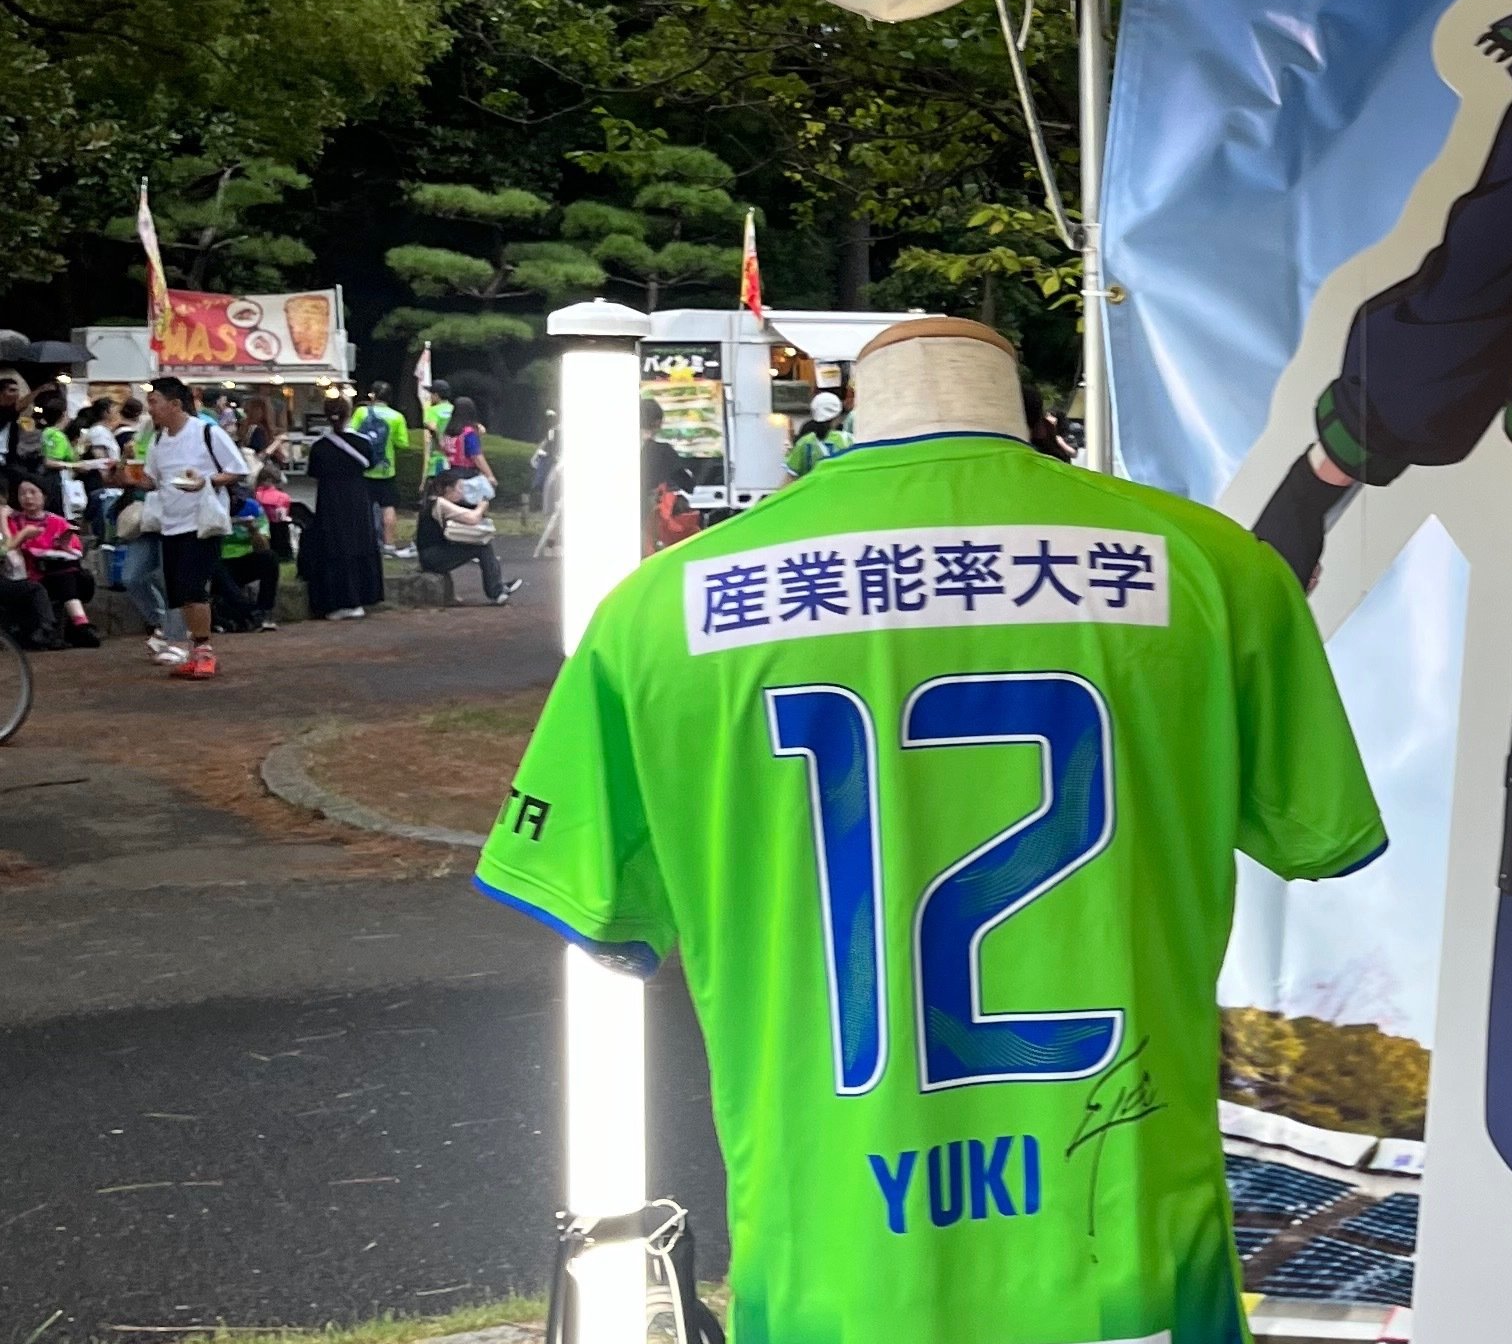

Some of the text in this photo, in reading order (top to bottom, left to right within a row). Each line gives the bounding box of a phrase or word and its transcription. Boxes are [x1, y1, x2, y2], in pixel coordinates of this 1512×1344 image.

[701, 540, 1156, 636] 産業能率大学
[763, 670, 1125, 1096] 12
[866, 1133, 1042, 1235] YUKI
